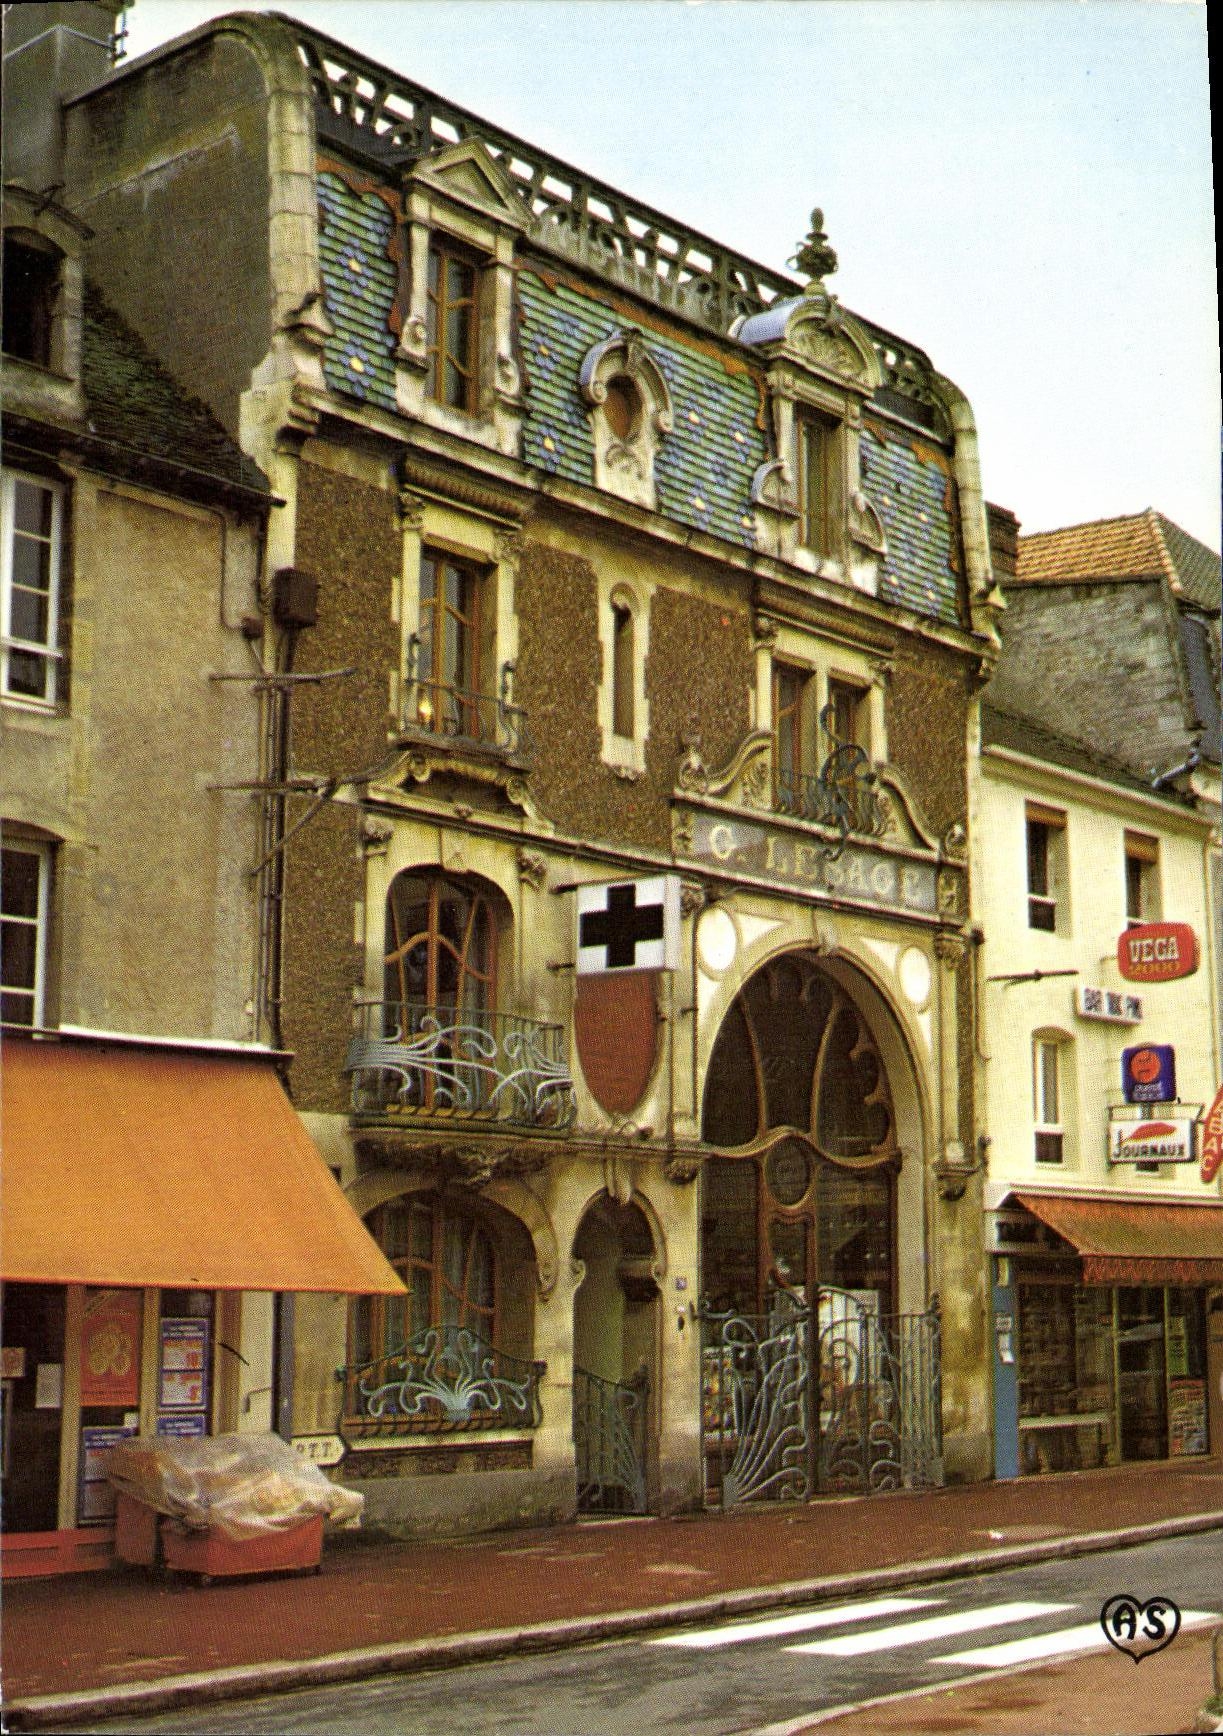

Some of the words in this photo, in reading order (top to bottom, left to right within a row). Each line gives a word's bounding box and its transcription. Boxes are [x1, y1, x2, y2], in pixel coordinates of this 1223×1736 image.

[765, 836, 922, 902] LESAGE
[1128, 936, 1180, 963] VEGA
[1113, 1130, 1185, 1159] JOURNAUX
